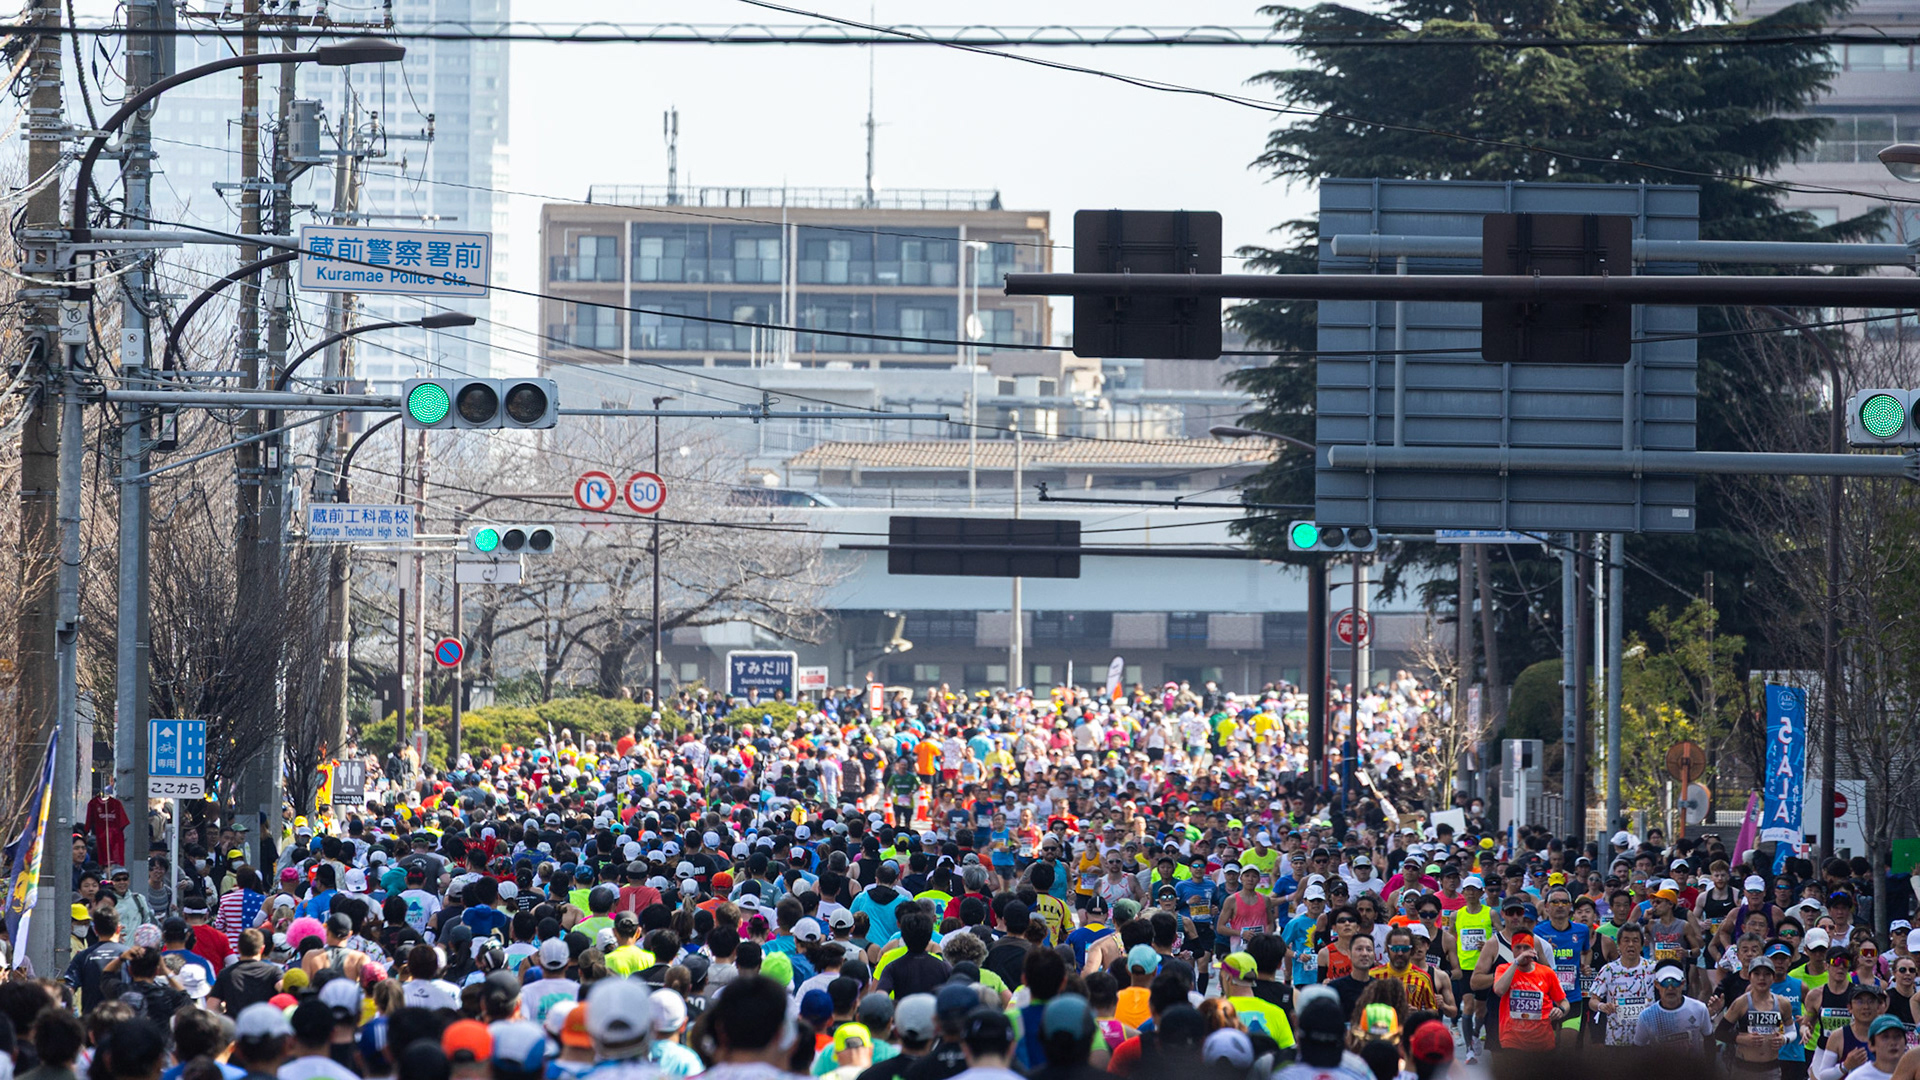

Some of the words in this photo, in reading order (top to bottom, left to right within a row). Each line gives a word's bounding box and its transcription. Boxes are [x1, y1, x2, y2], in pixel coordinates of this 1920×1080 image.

[307, 235, 482, 269] 蔵前警察署前
[316, 266, 384, 283] Kuramae
[390, 269, 435, 285] Police
[442, 271, 471, 288] Sta.
[633, 482, 657, 502] 50
[312, 508, 409, 525] 蔵前工科高校
[311, 525, 340, 536] Kuramae
[344, 526, 374, 537] Technical
[378, 527, 392, 539] High
[396, 526, 409, 538] Sch.
[734, 661, 789, 676] すみだ川
[157, 758, 176, 769] 専用
[151, 782, 201, 794] ここから
[1517, 1000, 1539, 1010] 25699
[1756, 1013, 1779, 1025] 12586
